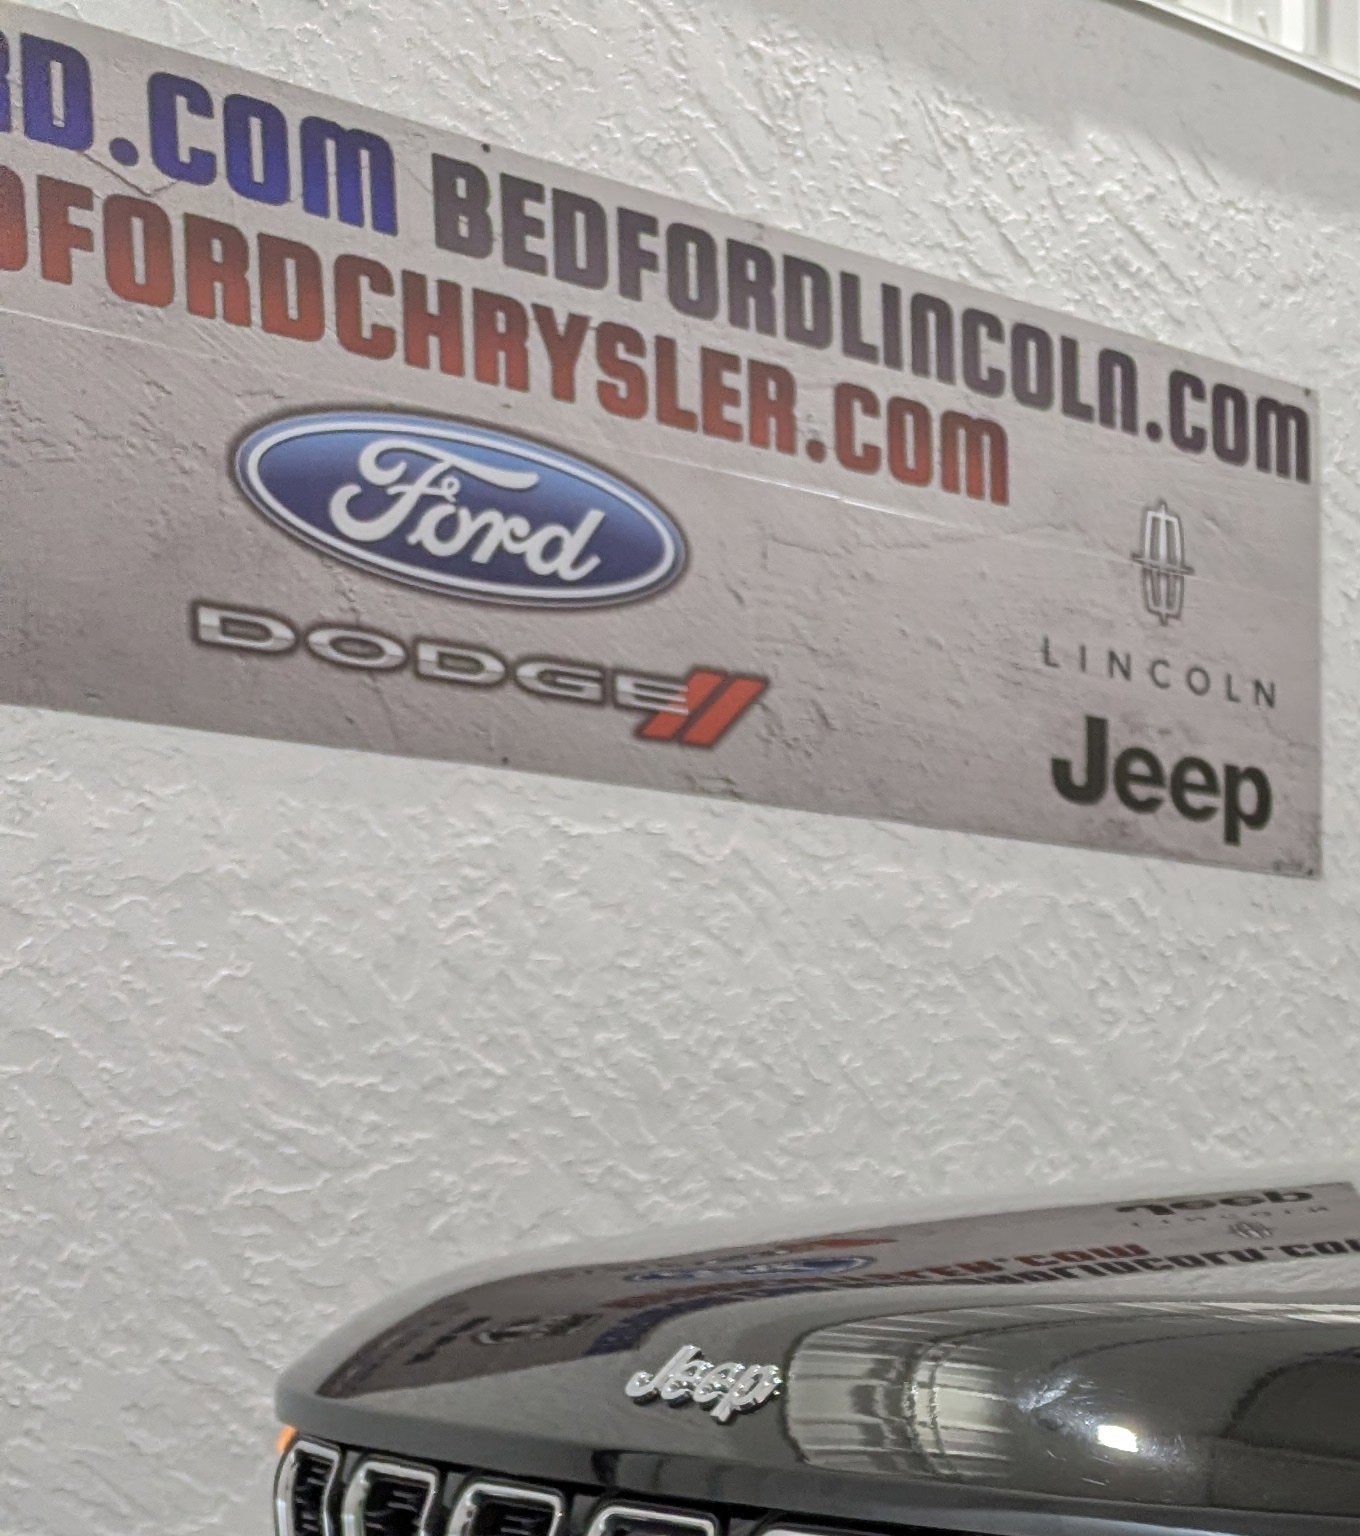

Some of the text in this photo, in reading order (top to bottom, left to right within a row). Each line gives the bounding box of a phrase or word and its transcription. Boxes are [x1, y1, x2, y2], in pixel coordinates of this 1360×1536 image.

[0, 31, 397, 236] D.COM
[330, 439, 603, 582] Ford
[192, 602, 690, 717] DODGE
[1040, 636, 1277, 709] LINCOLN
[1050, 715, 1273, 846] Jeep
[624, 1344, 782, 1423] Jeep
